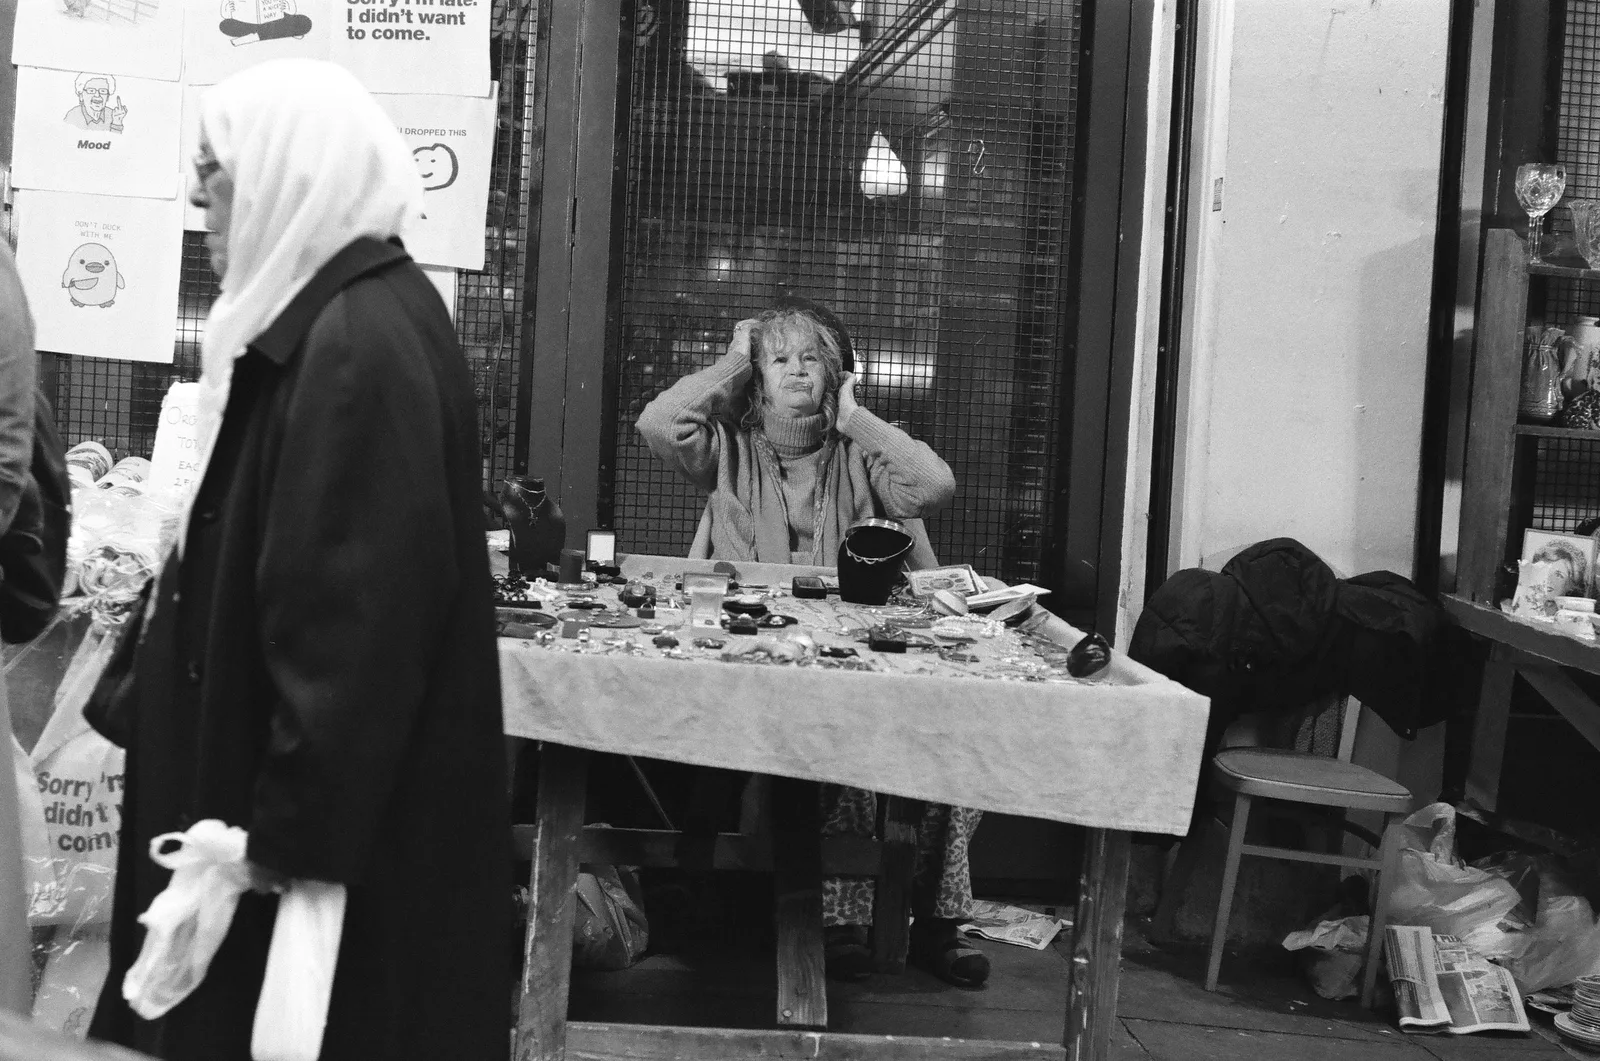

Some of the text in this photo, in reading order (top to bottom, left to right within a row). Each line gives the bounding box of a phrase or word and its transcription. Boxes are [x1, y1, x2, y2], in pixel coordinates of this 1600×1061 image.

[264, 11, 277, 19] WAY
[347, 8, 466, 25] I didn't want
[346, 26, 431, 41] to come.
[404, 127, 447, 136] DROPPED
[448, 129, 467, 137] THIS
[77, 140, 112, 150] Mood
[75, 220, 121, 231] DON'T DUCK
[80, 230, 100, 239] WITH
[166, 406, 198, 426] ORG
[177, 436, 198, 450] TOT
[178, 460, 200, 472] EAC
[37, 771, 92, 802] Sorry
[44, 801, 108, 828] didnt
[58, 832, 113, 853] com
